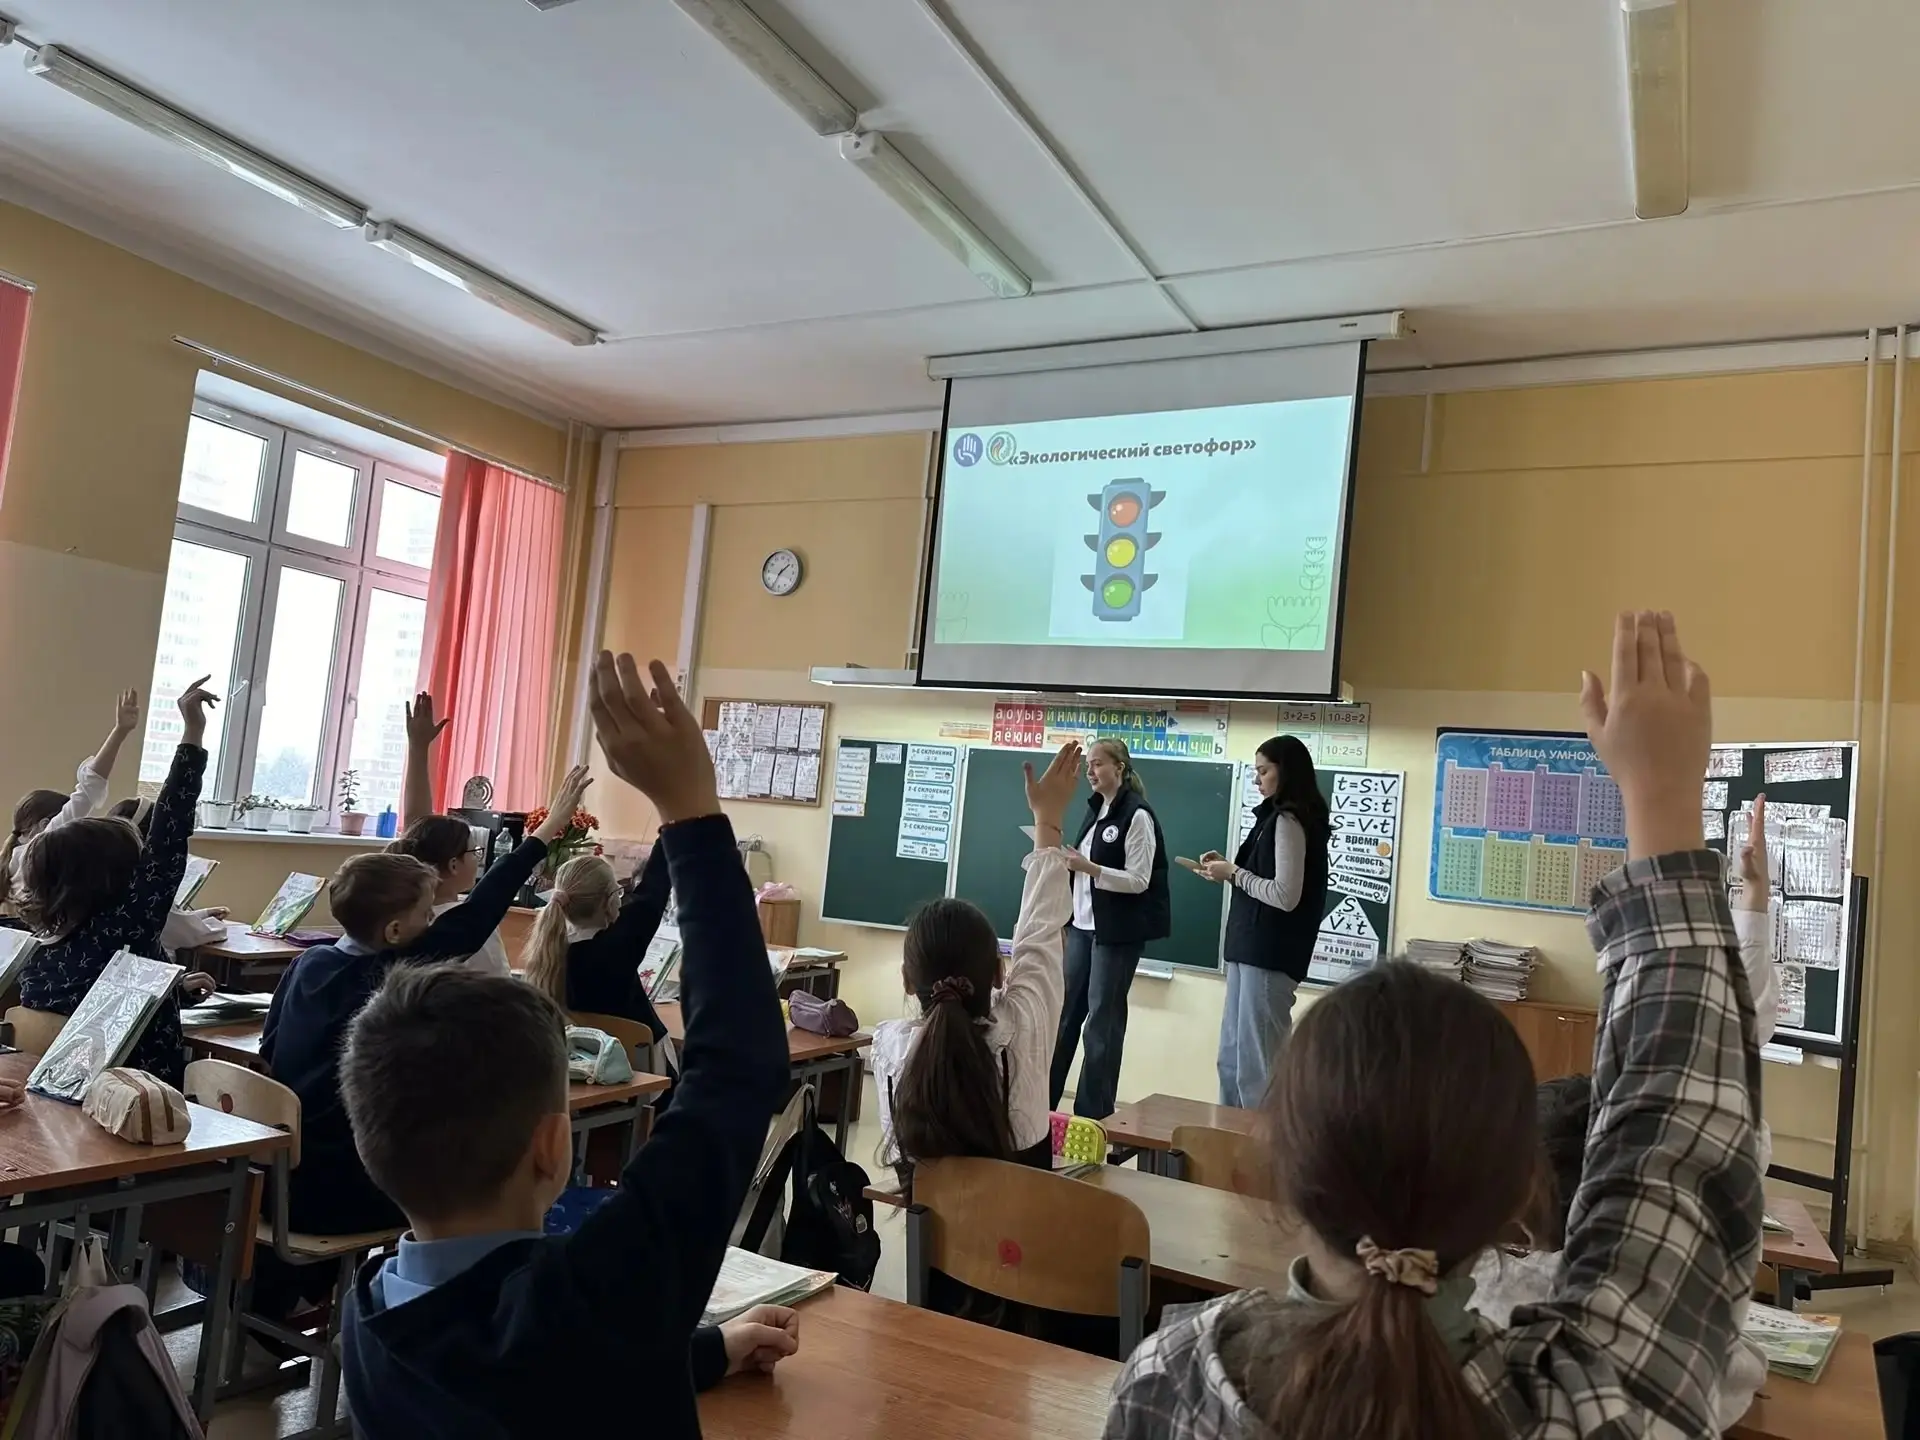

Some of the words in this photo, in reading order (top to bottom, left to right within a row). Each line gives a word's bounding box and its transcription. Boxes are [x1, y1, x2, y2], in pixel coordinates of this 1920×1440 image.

[1008, 442, 1150, 466] «Экологический
[1153, 438, 1256, 458] светофор»
[1283, 711, 1317, 721] 3+2=5
[1328, 713, 1366, 723] 10-8=2
[1326, 745, 1363, 756] 10:2=5
[1490, 747, 1546, 759] ТАБЛИЦА
[1549, 750, 1600, 761] УМНОЖ
[1345, 835, 1379, 847] время
[1345, 855, 1384, 867] скорость
[1340, 875, 1389, 893] расстояние
